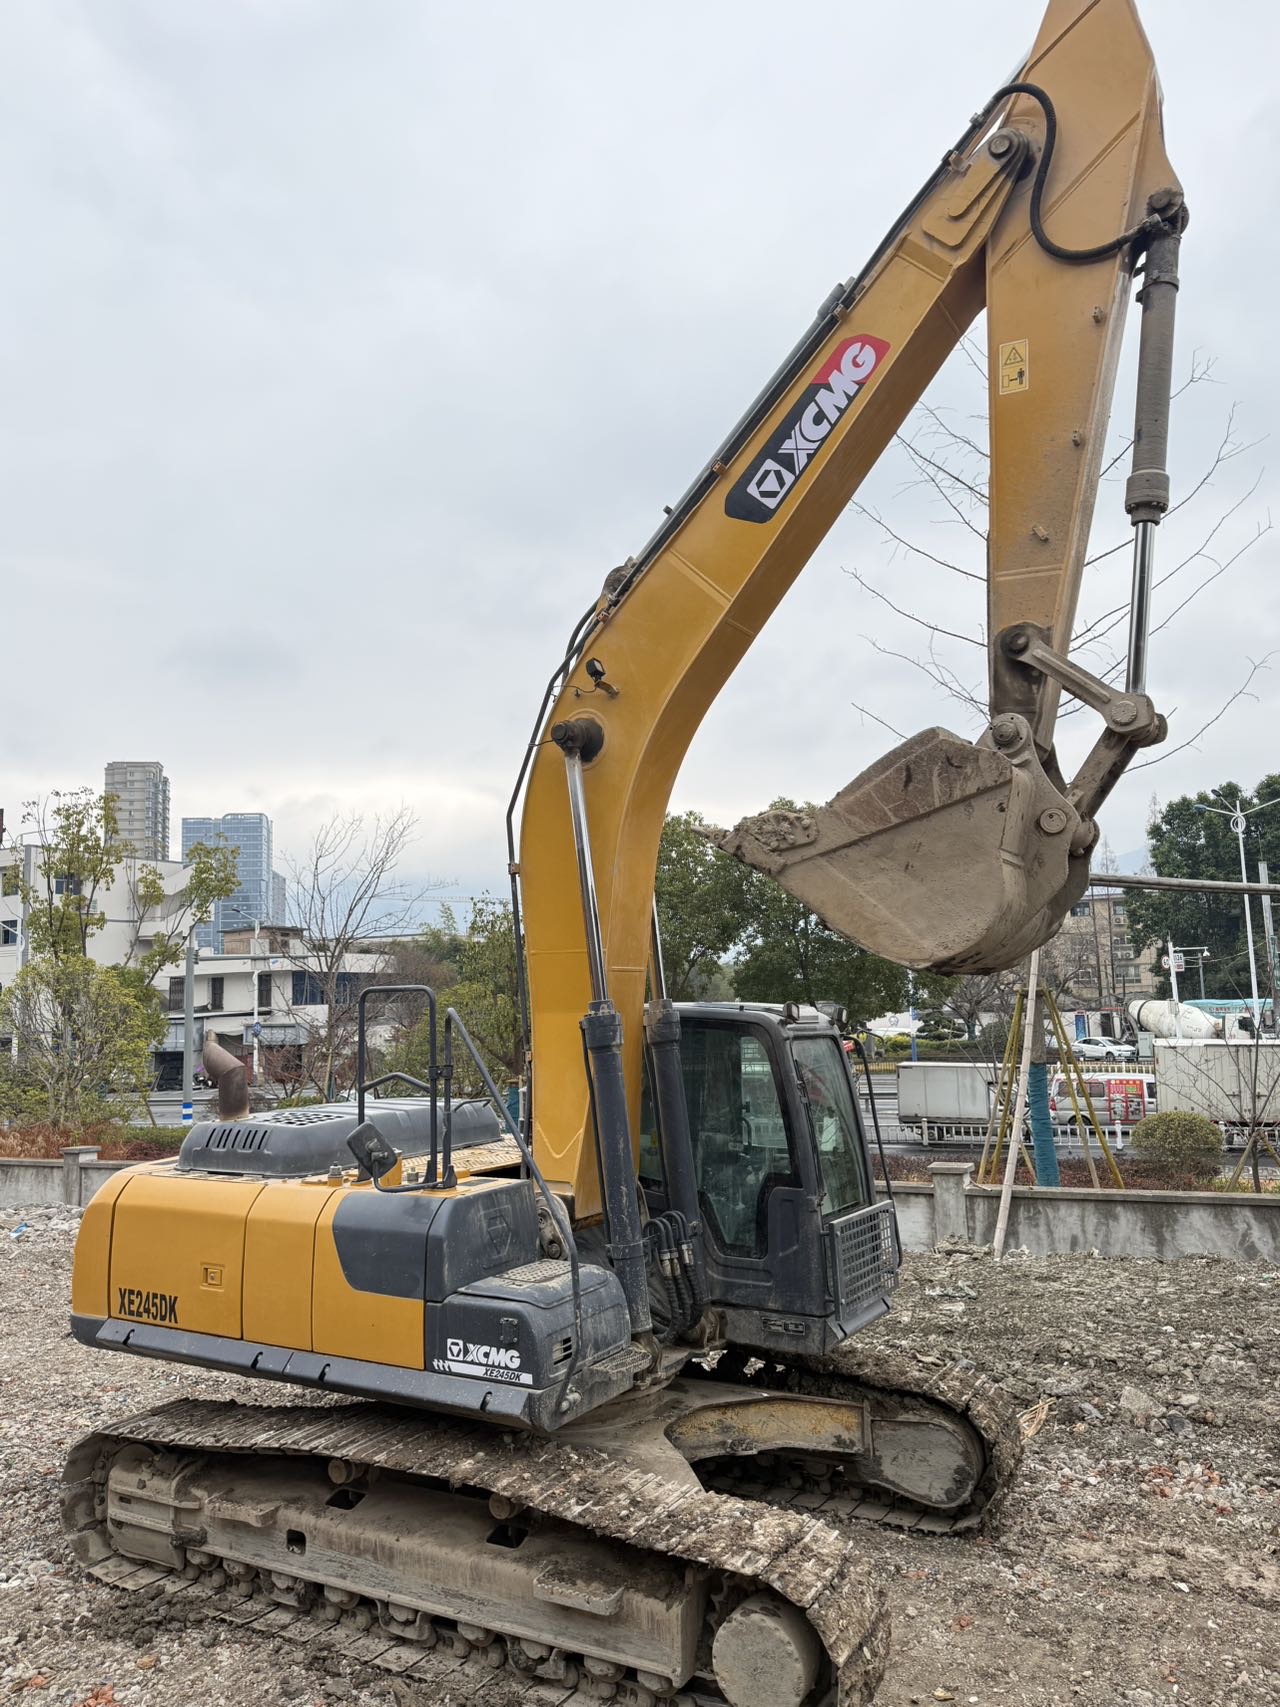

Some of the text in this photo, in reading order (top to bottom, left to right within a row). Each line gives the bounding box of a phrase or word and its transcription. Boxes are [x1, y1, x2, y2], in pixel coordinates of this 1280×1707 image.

[778, 342, 877, 476] XCMG
[118, 1287, 179, 1324] XE245DK
[463, 1343, 521, 1369] XCMG
[483, 1368, 523, 1382] XE245DK
